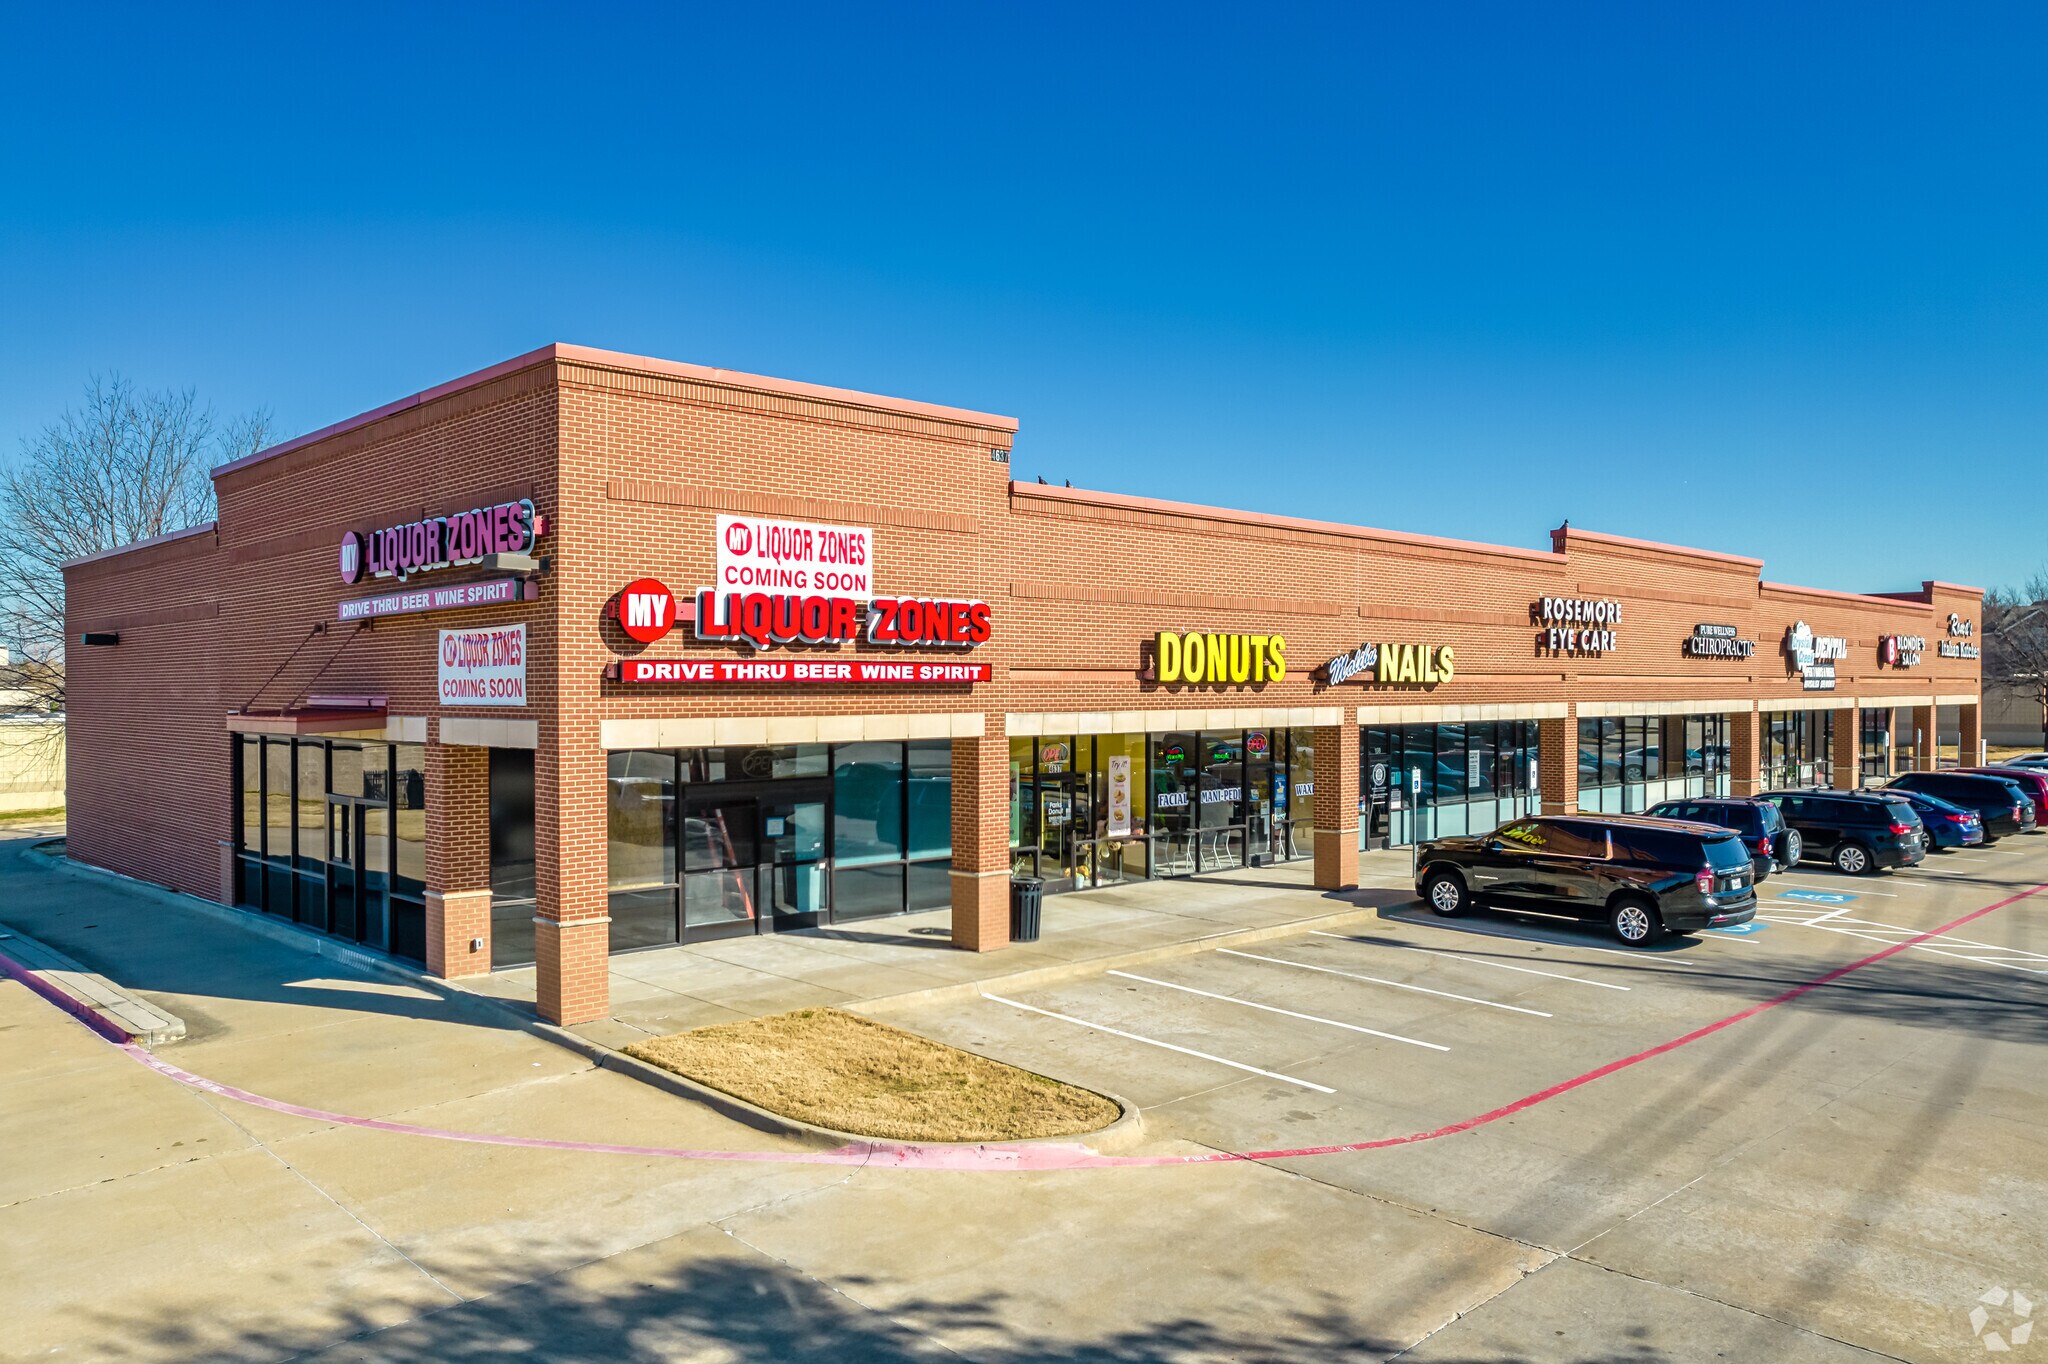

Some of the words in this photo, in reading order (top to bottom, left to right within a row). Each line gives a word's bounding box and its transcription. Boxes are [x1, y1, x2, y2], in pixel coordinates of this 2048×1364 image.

[992, 449, 1008, 462] 4637
[342, 544, 356, 572] MY
[368, 521, 440, 577] LIQUOR
[447, 502, 524, 560] ZONES
[729, 526, 749, 551] MY
[756, 525, 813, 566] LIQUOR
[818, 531, 866, 566] ZONES
[725, 566, 807, 589] COMING
[814, 572, 867, 592] SOON
[342, 601, 370, 617] DRIVE
[372, 598, 399, 613] THRU
[402, 593, 430, 610] BEER
[435, 588, 465, 606] WINE
[467, 583, 508, 602] SPIRIT
[1543, 597, 1622, 624] ROSEMORE
[628, 593, 668, 627] MY
[702, 591, 857, 644] LIQUOR
[875, 599, 992, 643] ZONES
[1550, 628, 1575, 651] EYE
[1581, 629, 1617, 652] CARE
[1700, 625, 1713, 635] PURE
[1713, 626, 1736, 637] WELLNESS
[457, 633, 490, 674] LIQUOR
[491, 629, 522, 667] ZONES
[1692, 636, 1756, 657] CHIROPRACTIC
[1815, 636, 1848, 659] DENTAL
[1888, 638, 1895, 662] B
[1897, 635, 1926, 651] BLONDIE'S
[1159, 631, 1286, 683] DONUTS
[1329, 642, 1377, 686] Malibu
[1380, 643, 1454, 683] NAILS
[1902, 653, 1921, 666] SALON
[636, 662, 714, 680] DRIVE
[721, 663, 786, 680] THRU
[794, 664, 852, 679] BEER
[860, 664, 915, 680] WINE
[919, 665, 982, 680] SPIRIT
[443, 678, 487, 698] COMING
[489, 677, 523, 698] SOON
[1247, 737, 1265, 750] OPEN
[1111, 760, 1120, 770] Try
[1159, 793, 1188, 807] FACIAL
